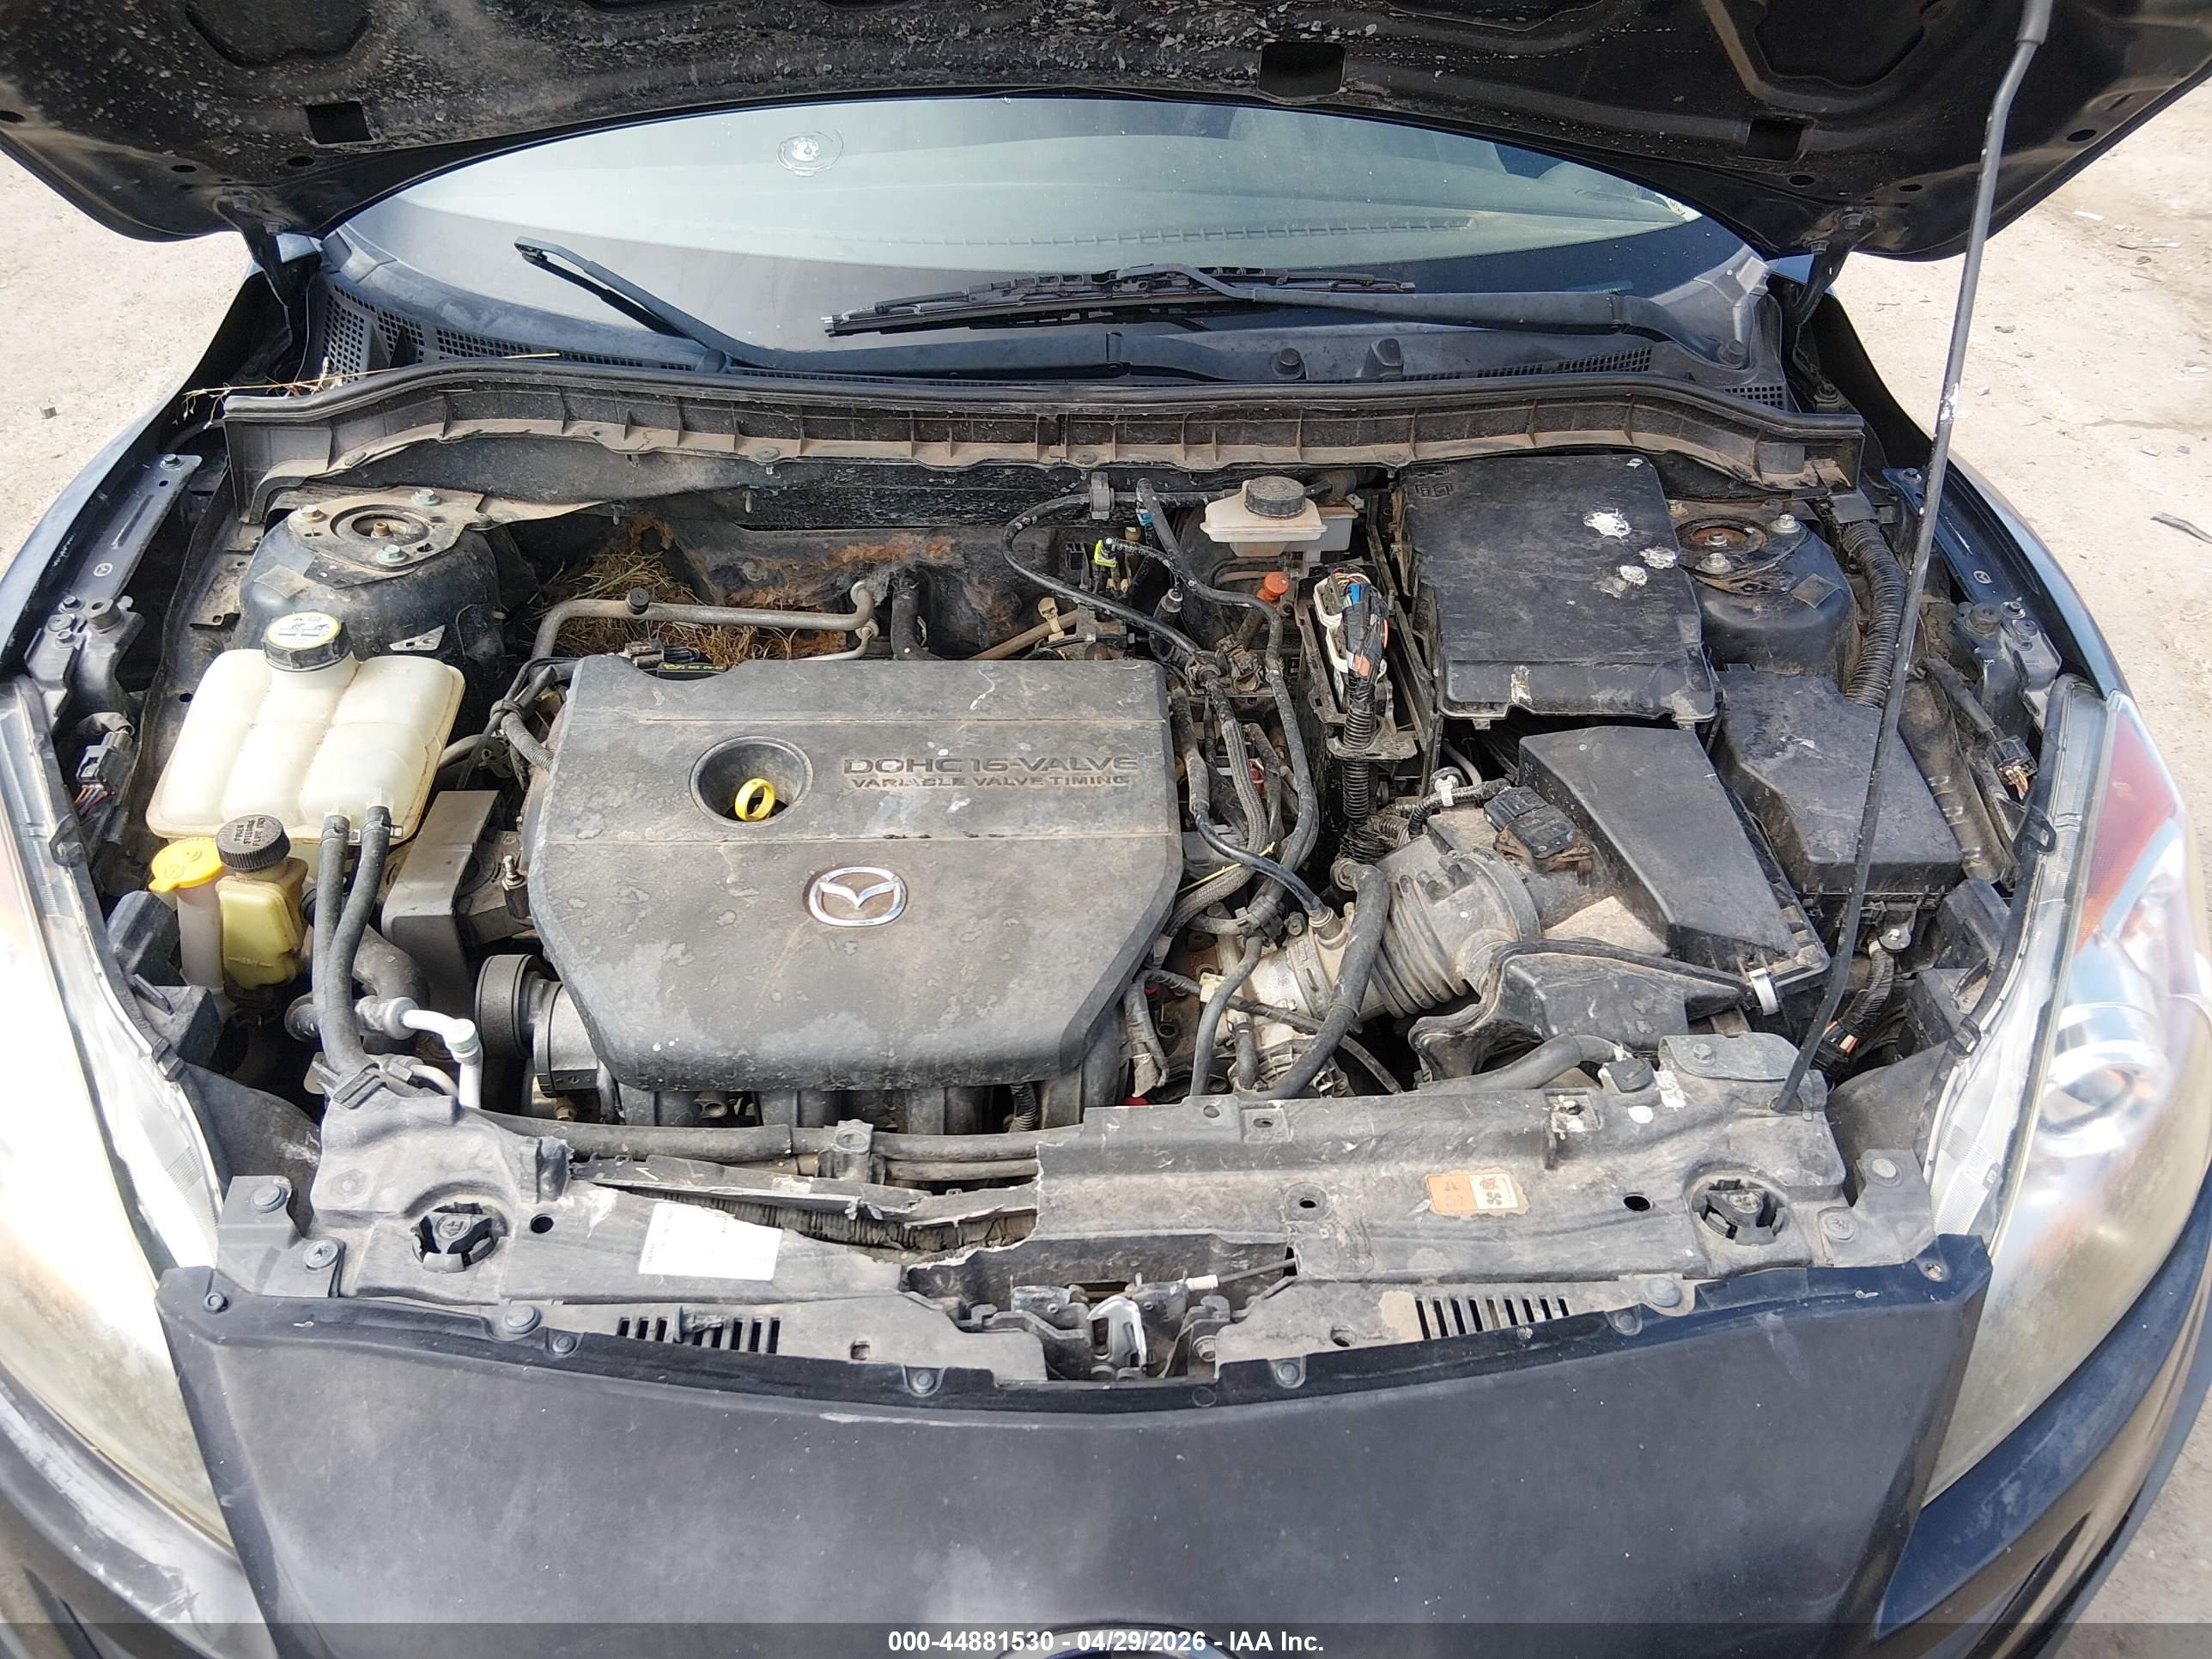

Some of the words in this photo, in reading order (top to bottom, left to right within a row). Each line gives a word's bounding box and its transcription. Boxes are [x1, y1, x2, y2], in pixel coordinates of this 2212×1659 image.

[843, 758, 963, 774] DOHC
[969, 757, 1139, 773] 16-VALVE
[972, 776, 1044, 787] VALVE
[1048, 775, 1130, 786] TIMING
